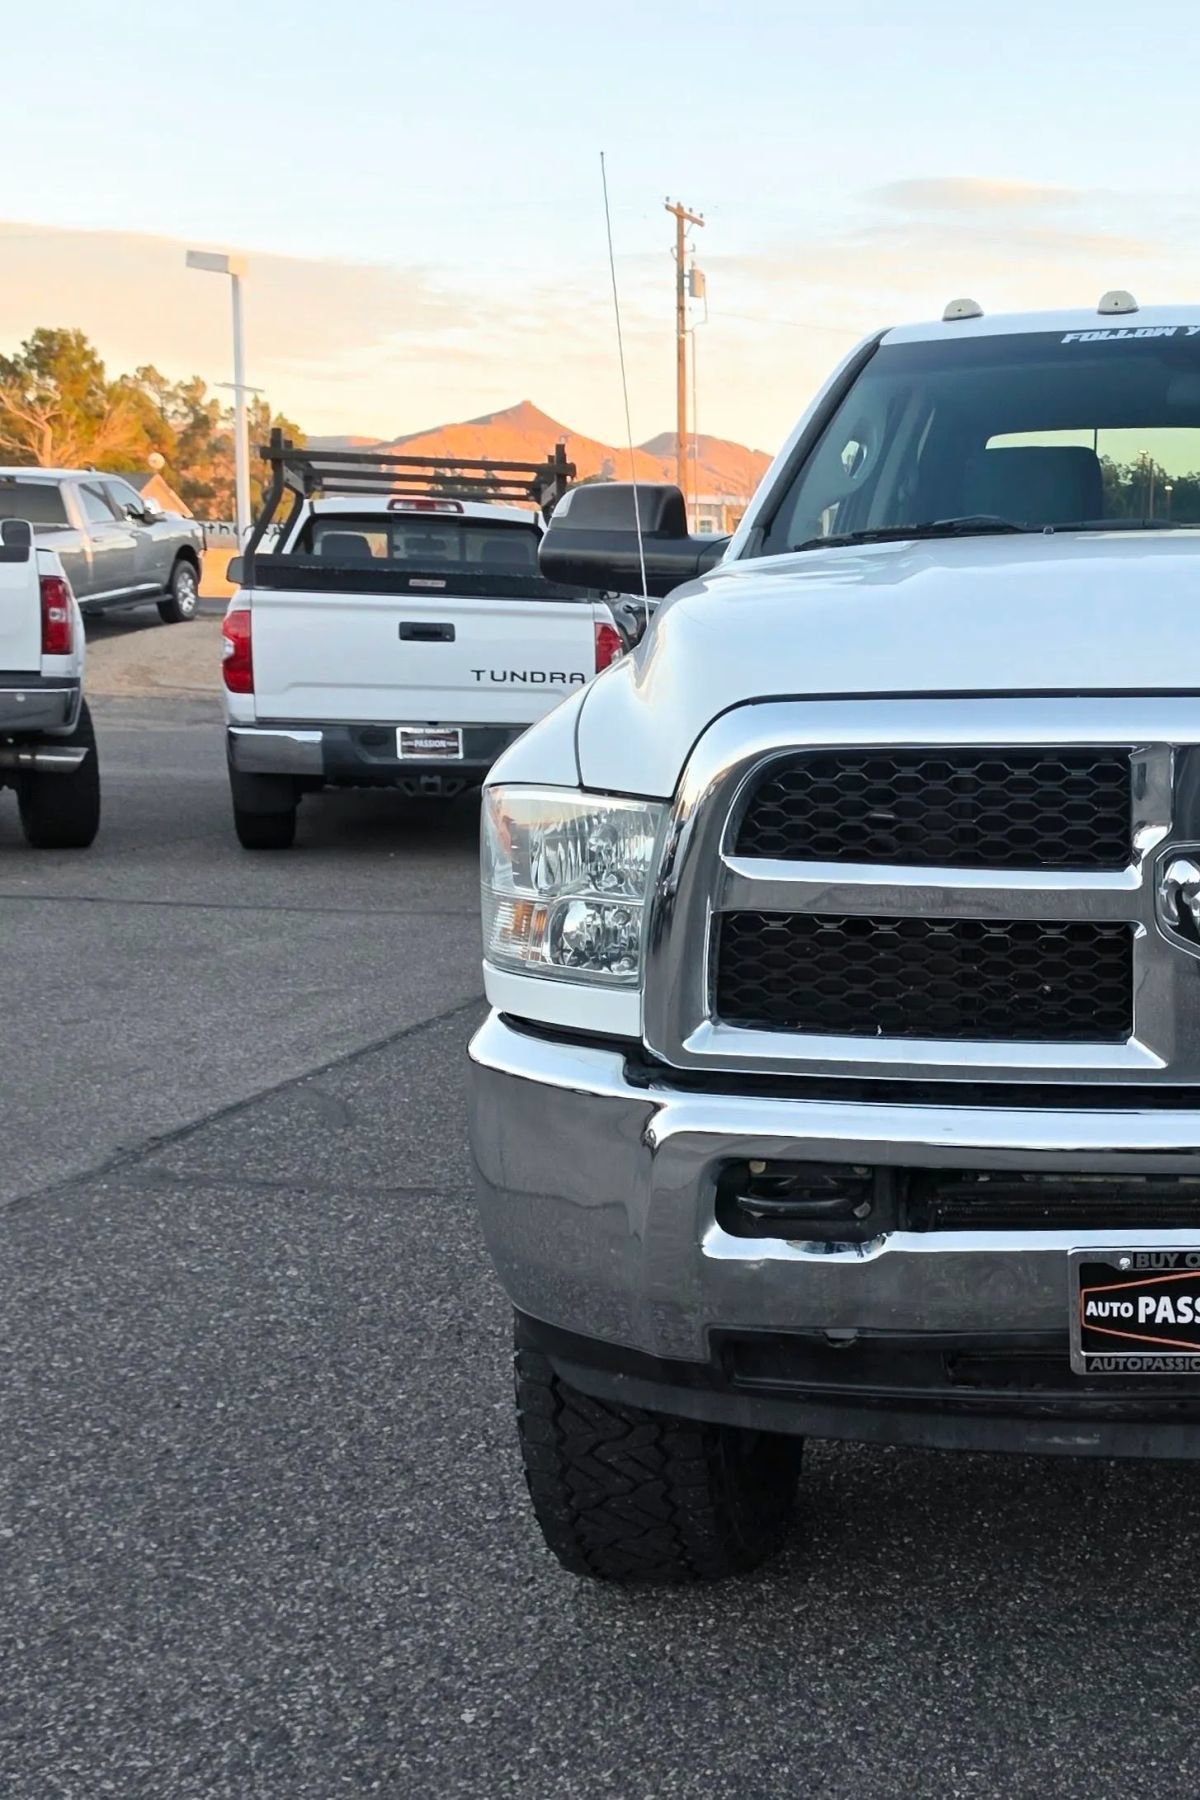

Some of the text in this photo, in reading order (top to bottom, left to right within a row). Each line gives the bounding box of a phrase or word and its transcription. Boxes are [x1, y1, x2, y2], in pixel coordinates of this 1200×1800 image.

[1060, 326, 1178, 344] FOLLOW
[470, 669, 586, 685] TUNDRA
[414, 739, 447, 749] PASSION
[1135, 1252, 1179, 1268] BUY
[1085, 1300, 1134, 1318] AUTO
